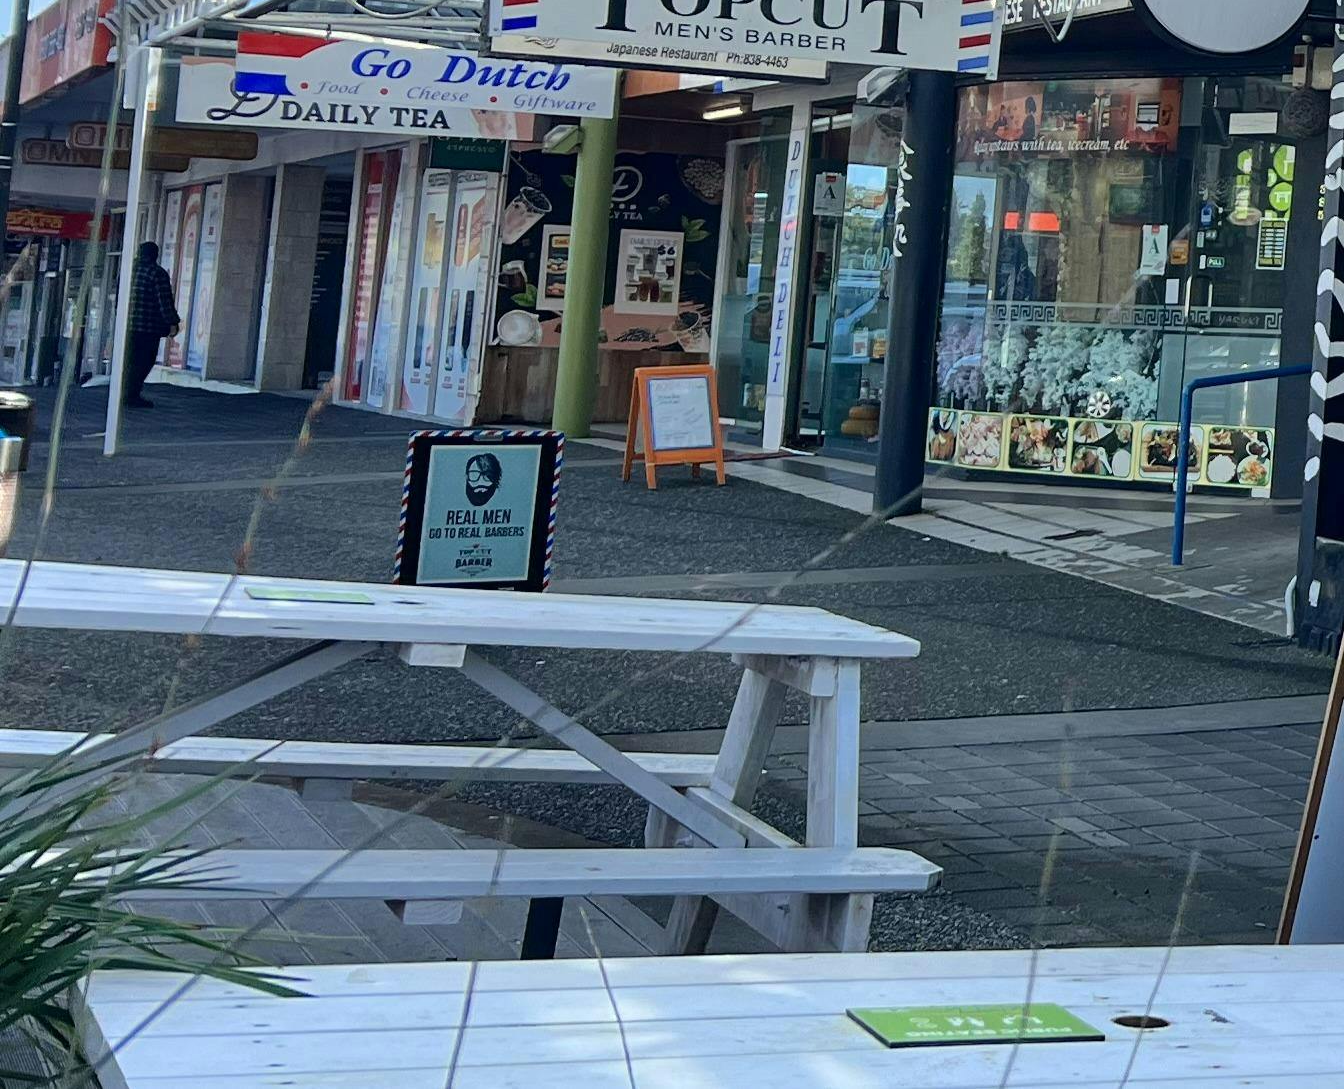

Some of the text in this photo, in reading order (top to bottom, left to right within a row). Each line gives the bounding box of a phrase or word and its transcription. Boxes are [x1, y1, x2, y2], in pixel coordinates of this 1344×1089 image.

[655, 21, 846, 52] MEN'S BARBER
[606, 42, 658, 57] Japanese
[660, 46, 719, 62] Restaurant
[351, 48, 571, 90] Go Dutch
[313, 80, 597, 111] Food Cheese Giftware
[280, 100, 451, 130] DAILY TEA
[1021, 136, 1045, 151] with
[1114, 139, 1130, 151] etc
[823, 185, 836, 200] A
[780, 140, 801, 268] DUTCH
[1148, 237, 1161, 255] A
[771, 281, 788, 383] DELI
[446, 509, 511, 525] REAL MEN
[429, 526, 525, 539] GO TO REAL BARBERS
[455, 558, 493, 569] BARBER
